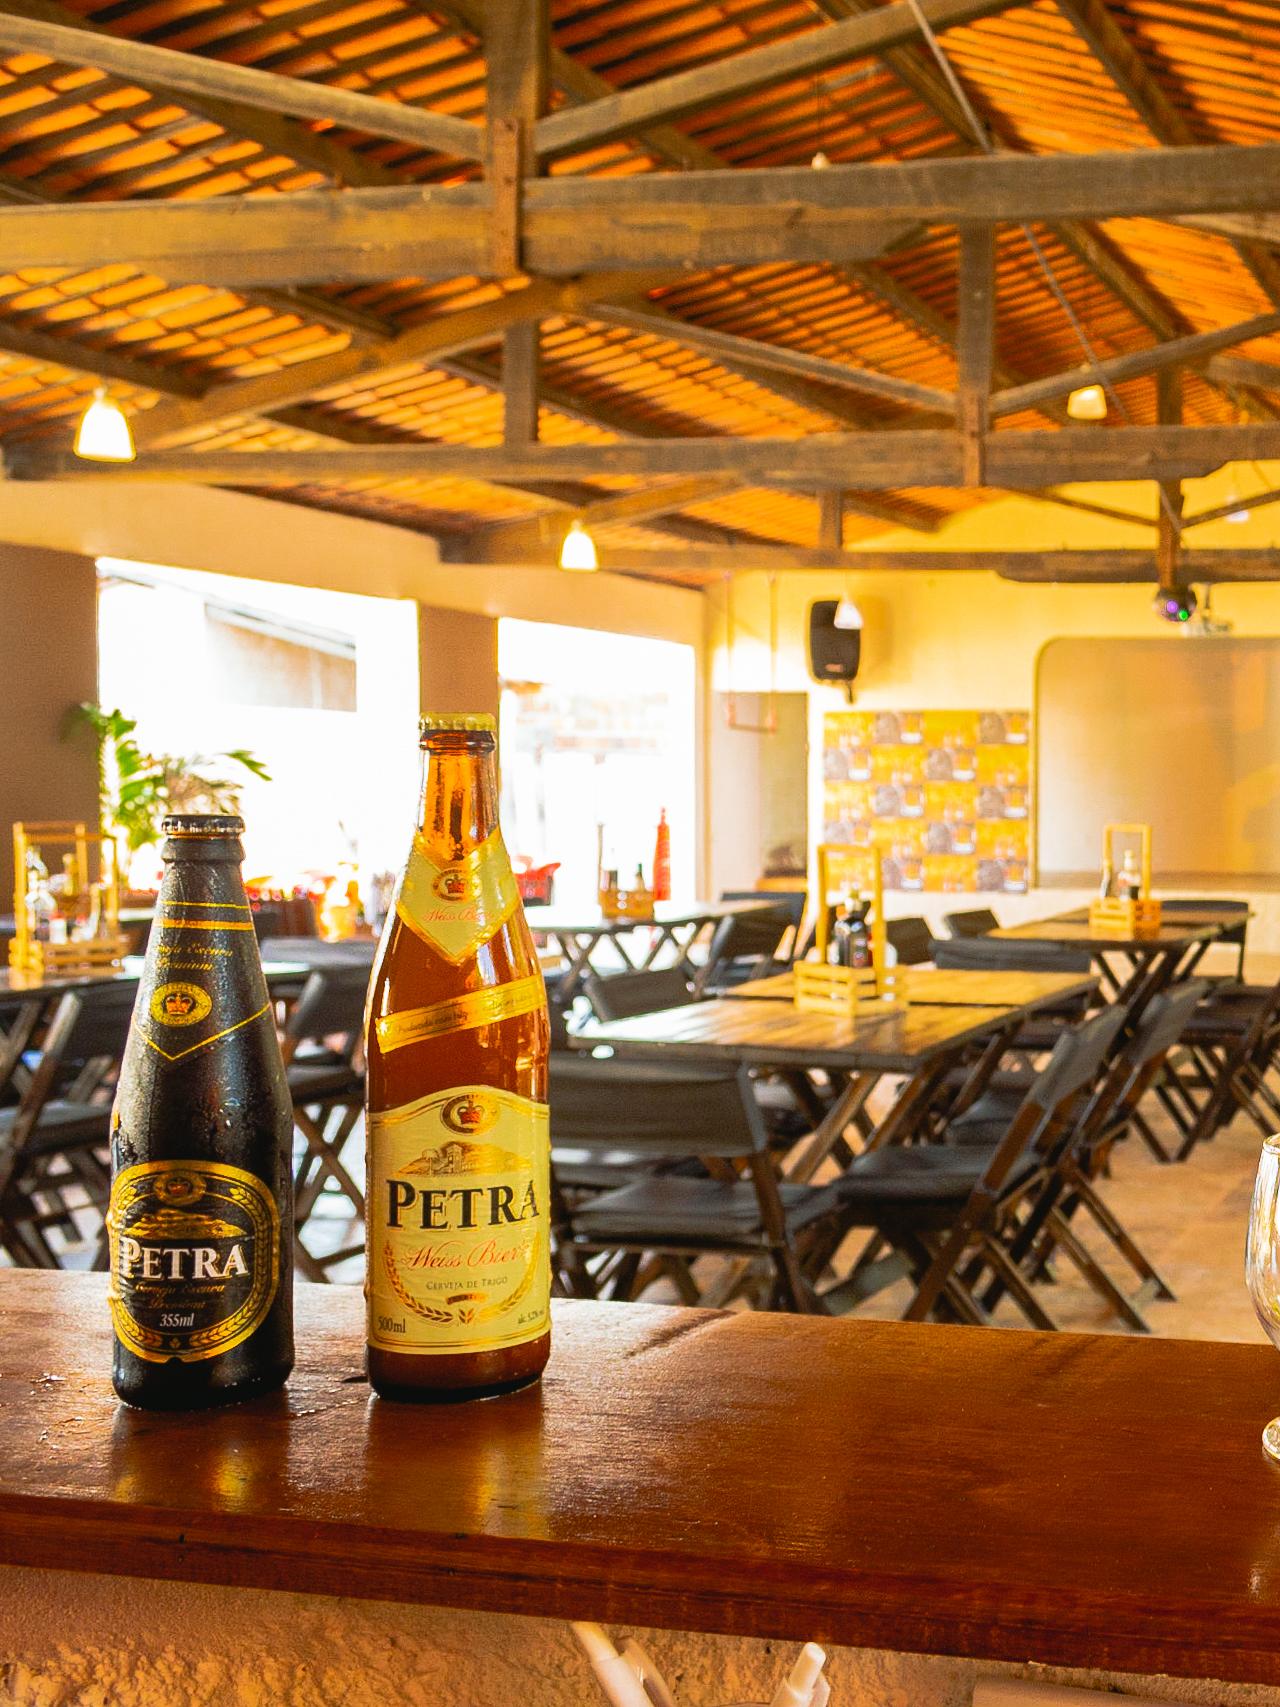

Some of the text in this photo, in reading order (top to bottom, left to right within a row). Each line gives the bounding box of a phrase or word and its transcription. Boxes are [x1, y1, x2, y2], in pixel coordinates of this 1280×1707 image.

[386, 1178, 540, 1230] PETRA
[119, 1235, 251, 1280] PETRA
[403, 1239, 521, 1272] Weiss Bier
[426, 1275, 508, 1290] CERVEJA DE TRIGO
[160, 1312, 195, 1328] 355ml
[378, 1315, 406, 1334] 500ml
